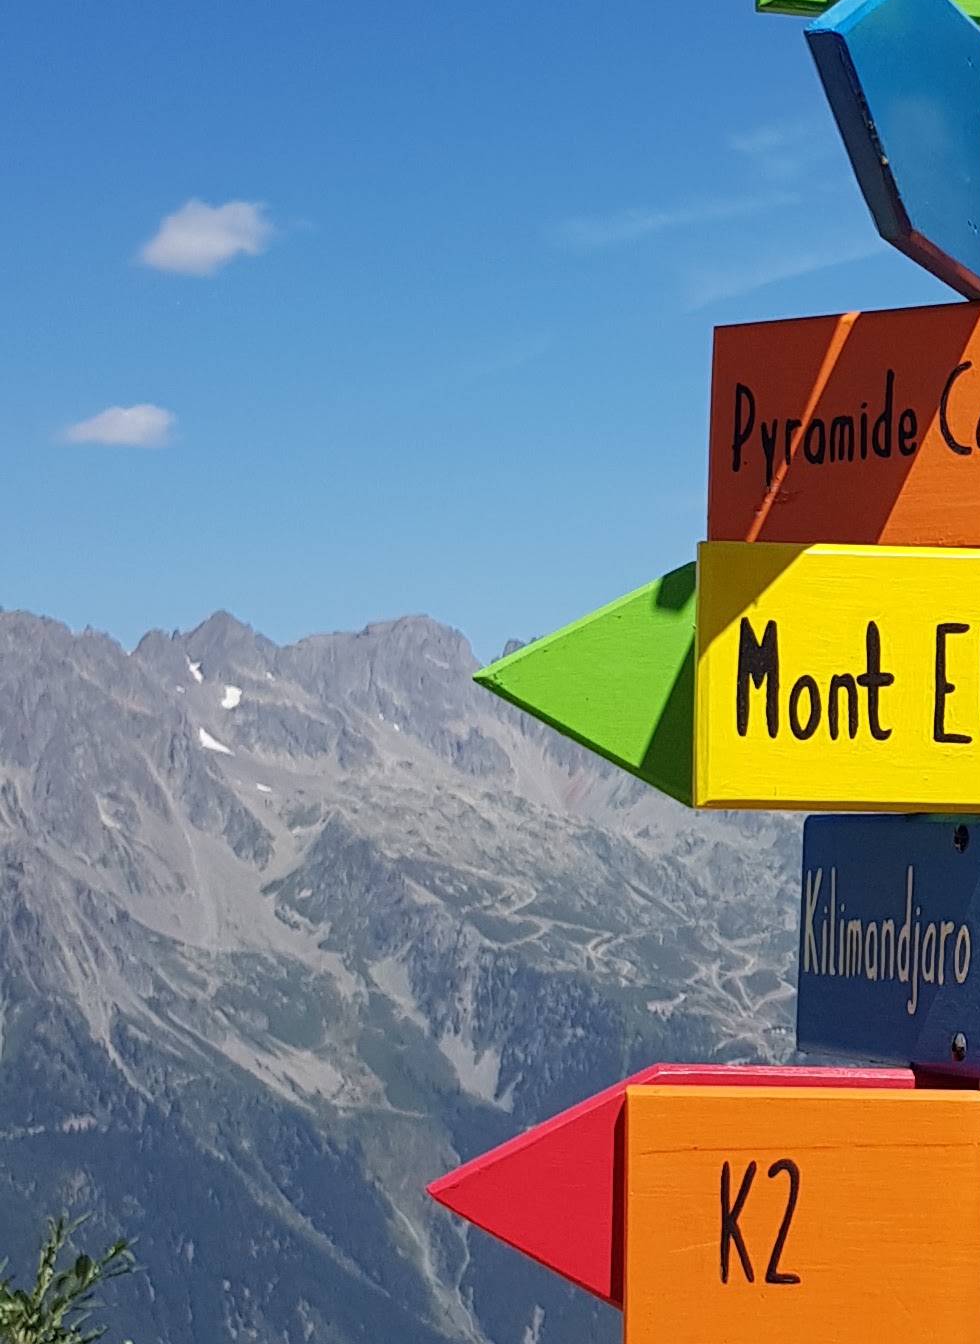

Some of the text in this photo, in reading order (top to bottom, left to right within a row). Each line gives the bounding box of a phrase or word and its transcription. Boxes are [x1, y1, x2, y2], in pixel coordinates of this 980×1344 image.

[731, 368, 919, 489] Pyramide
[736, 616, 894, 742] Mont
[802, 864, 972, 1016] Kilimandjaro
[719, 1158, 802, 1285] K2
